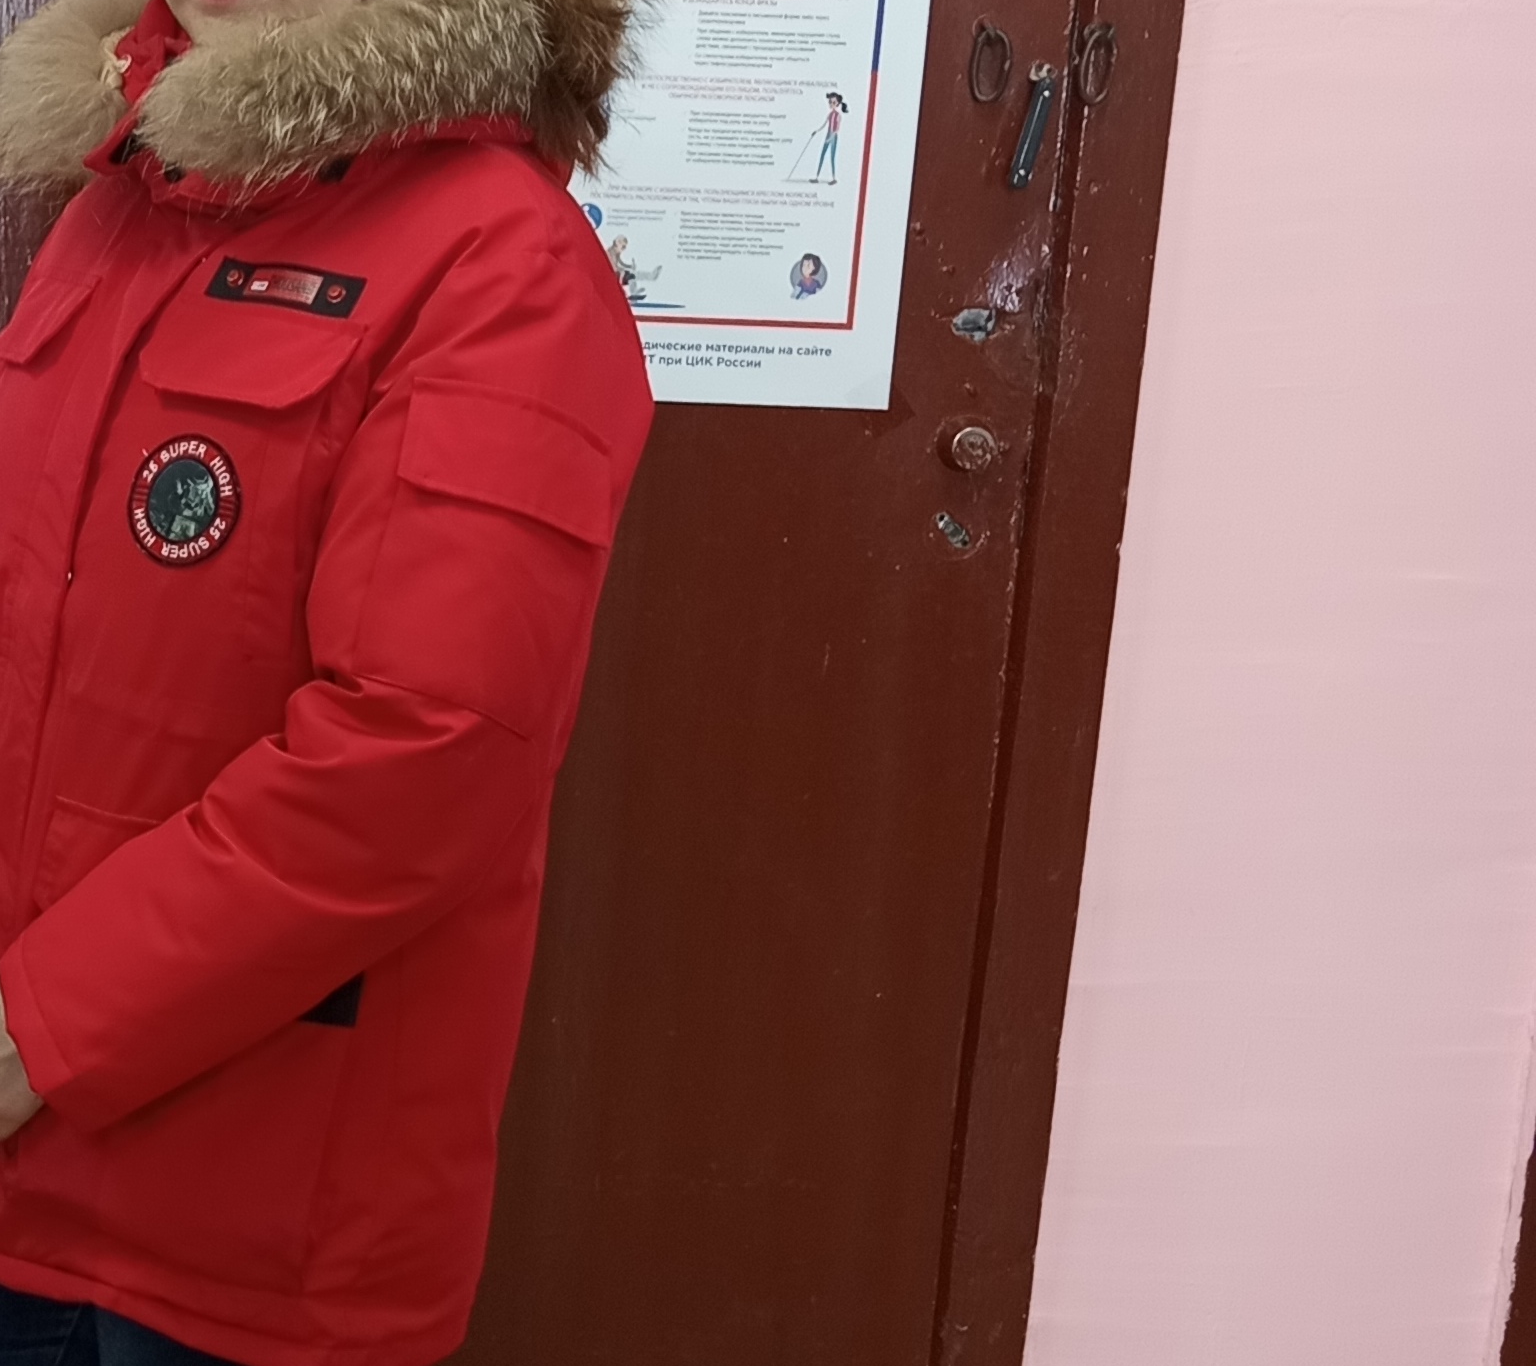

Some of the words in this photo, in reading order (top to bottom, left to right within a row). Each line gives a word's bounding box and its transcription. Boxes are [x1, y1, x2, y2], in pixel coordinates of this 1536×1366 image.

[705, 343, 775, 355] материалы
[778, 346, 793, 355] на
[796, 345, 832, 356] сайте
[658, 356, 682, 366] при
[685, 355, 713, 367] ЦИК
[716, 356, 761, 368] России
[160, 441, 207, 463] SUPER
[210, 456, 233, 497] HIGH
[134, 507, 156, 547] HIGH
[161, 537, 210, 558] SUPER
